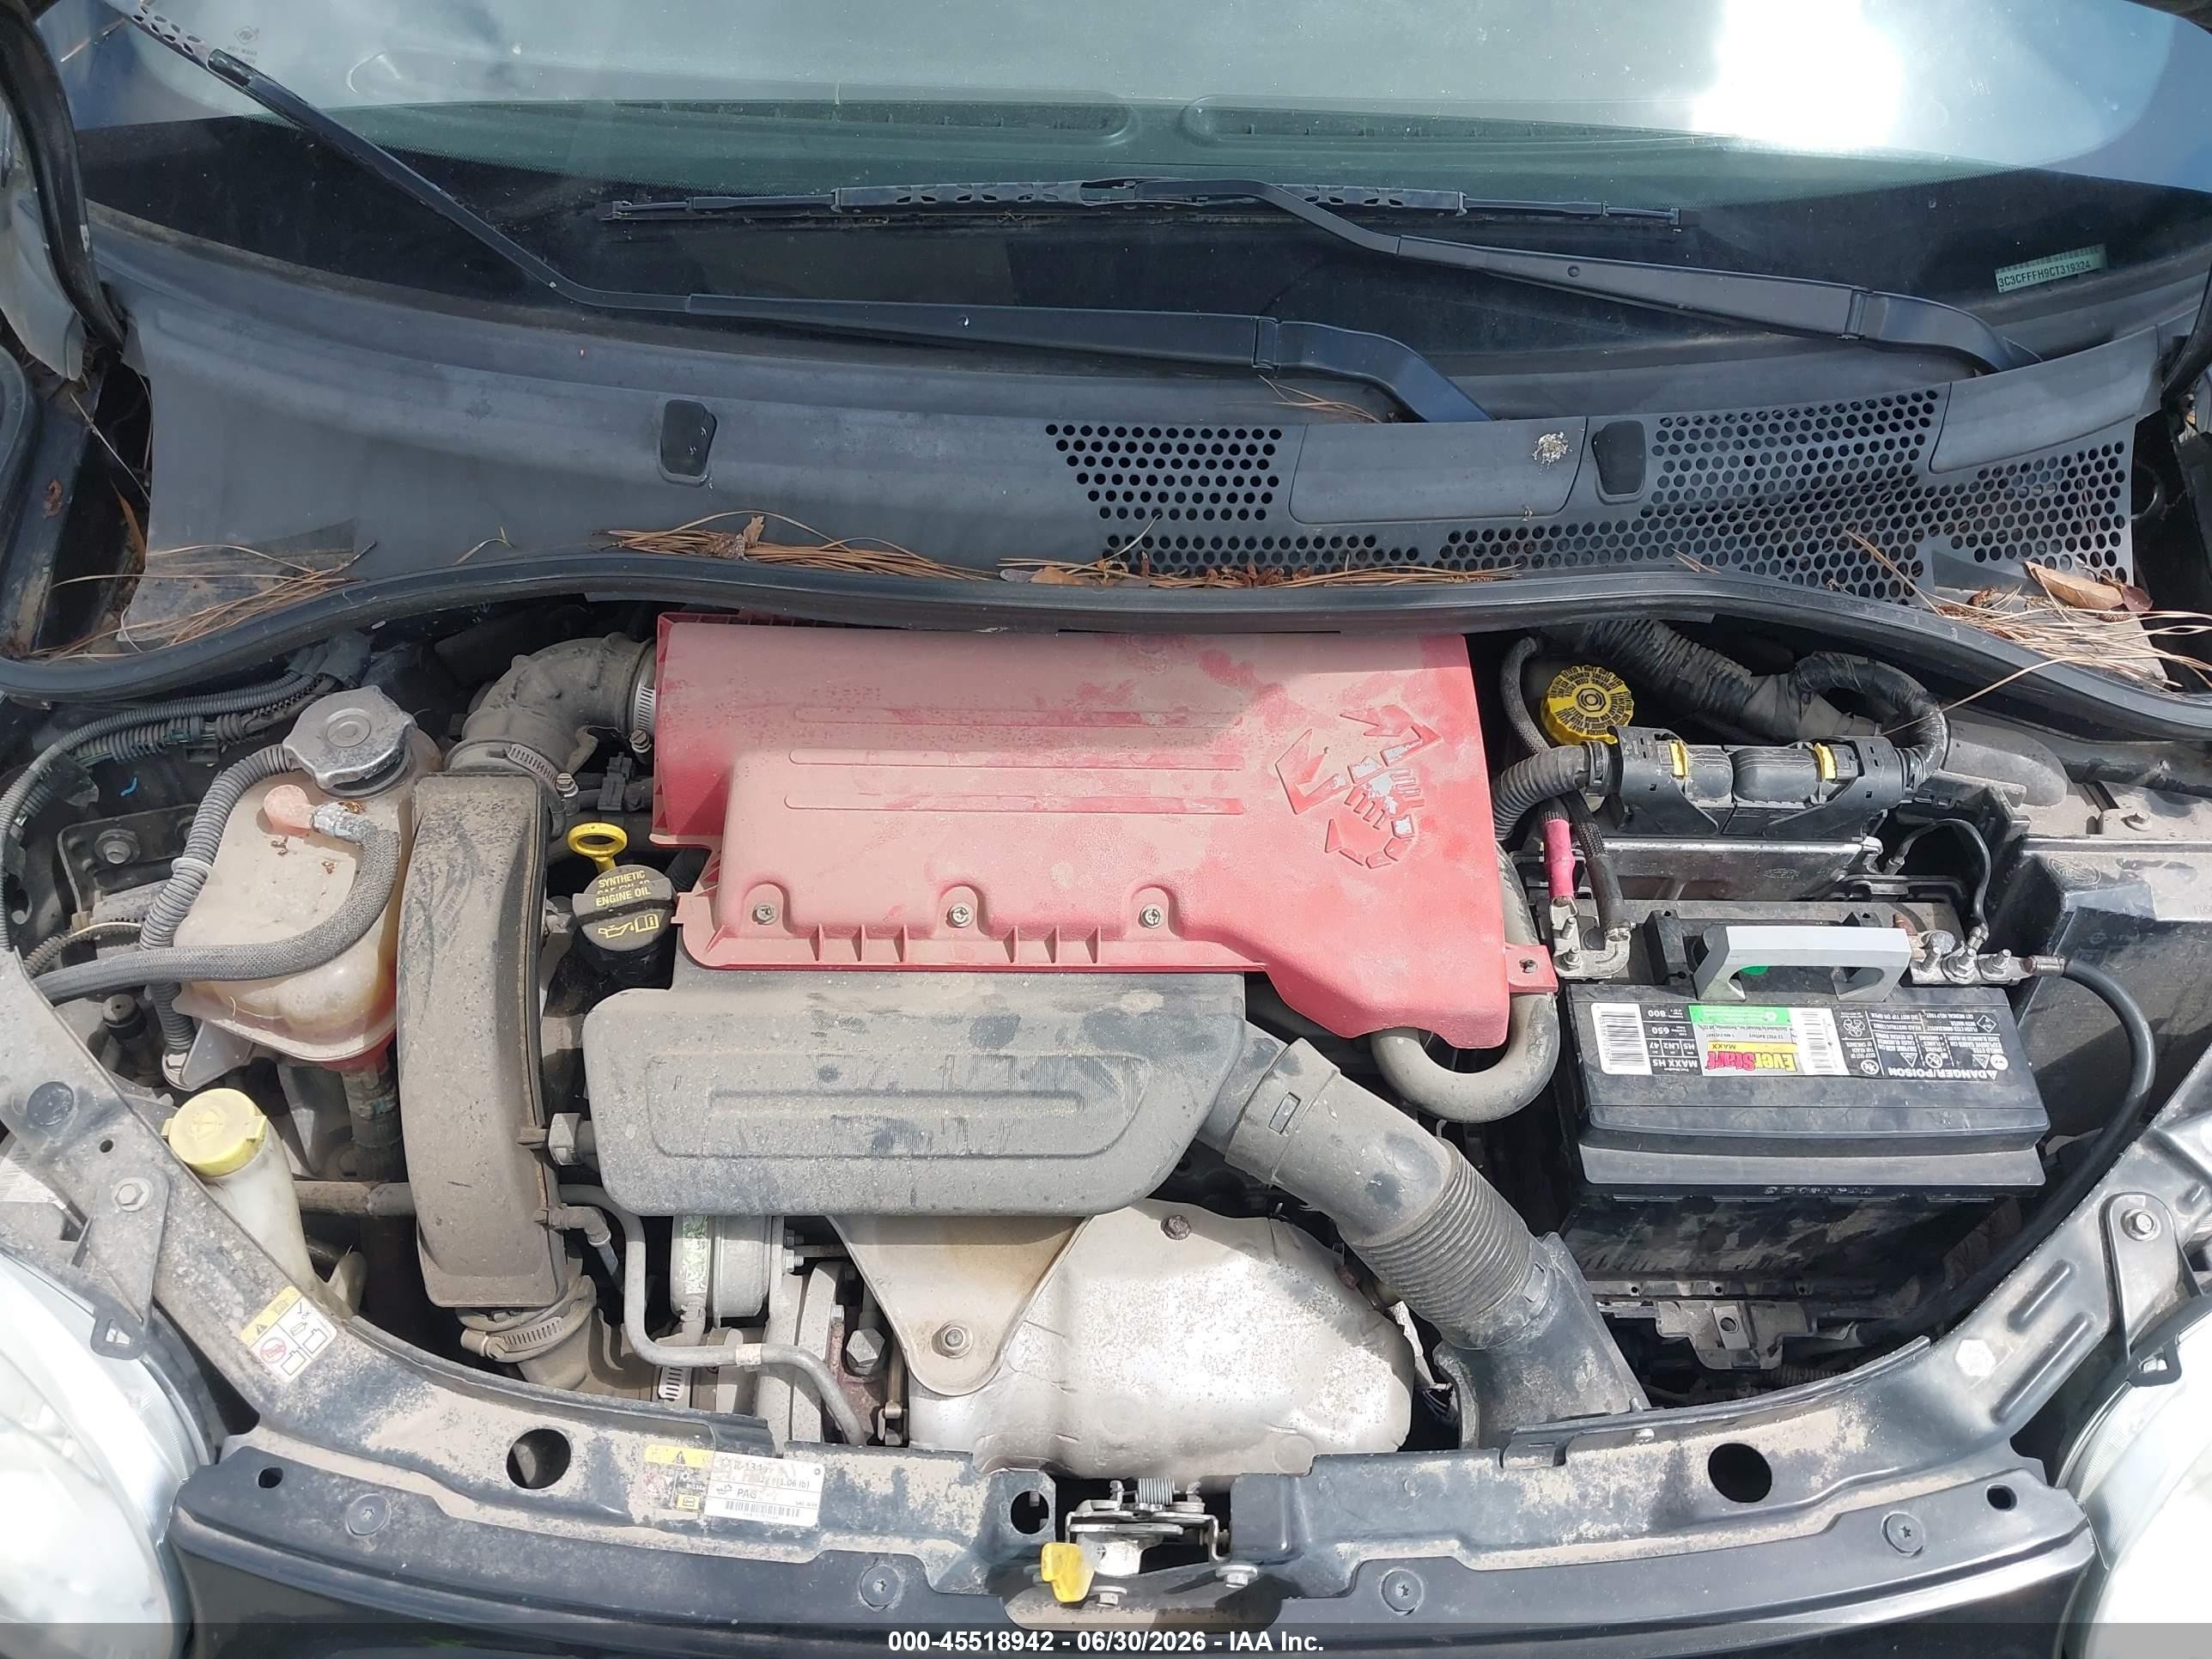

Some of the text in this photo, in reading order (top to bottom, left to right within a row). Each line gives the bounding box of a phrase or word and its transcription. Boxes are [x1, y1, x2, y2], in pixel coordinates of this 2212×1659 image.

[1998, 260, 2090, 287] 3C3CFFFH9CT319324
[599, 871, 645, 888] SYNTHETIC
[596, 886, 652, 907] ENGINE OIL
[1706, 1051, 1796, 1072] EverStart
[1887, 1067, 1987, 1079] DANGER/POISON
[737, 1488, 757, 1498] PAG
